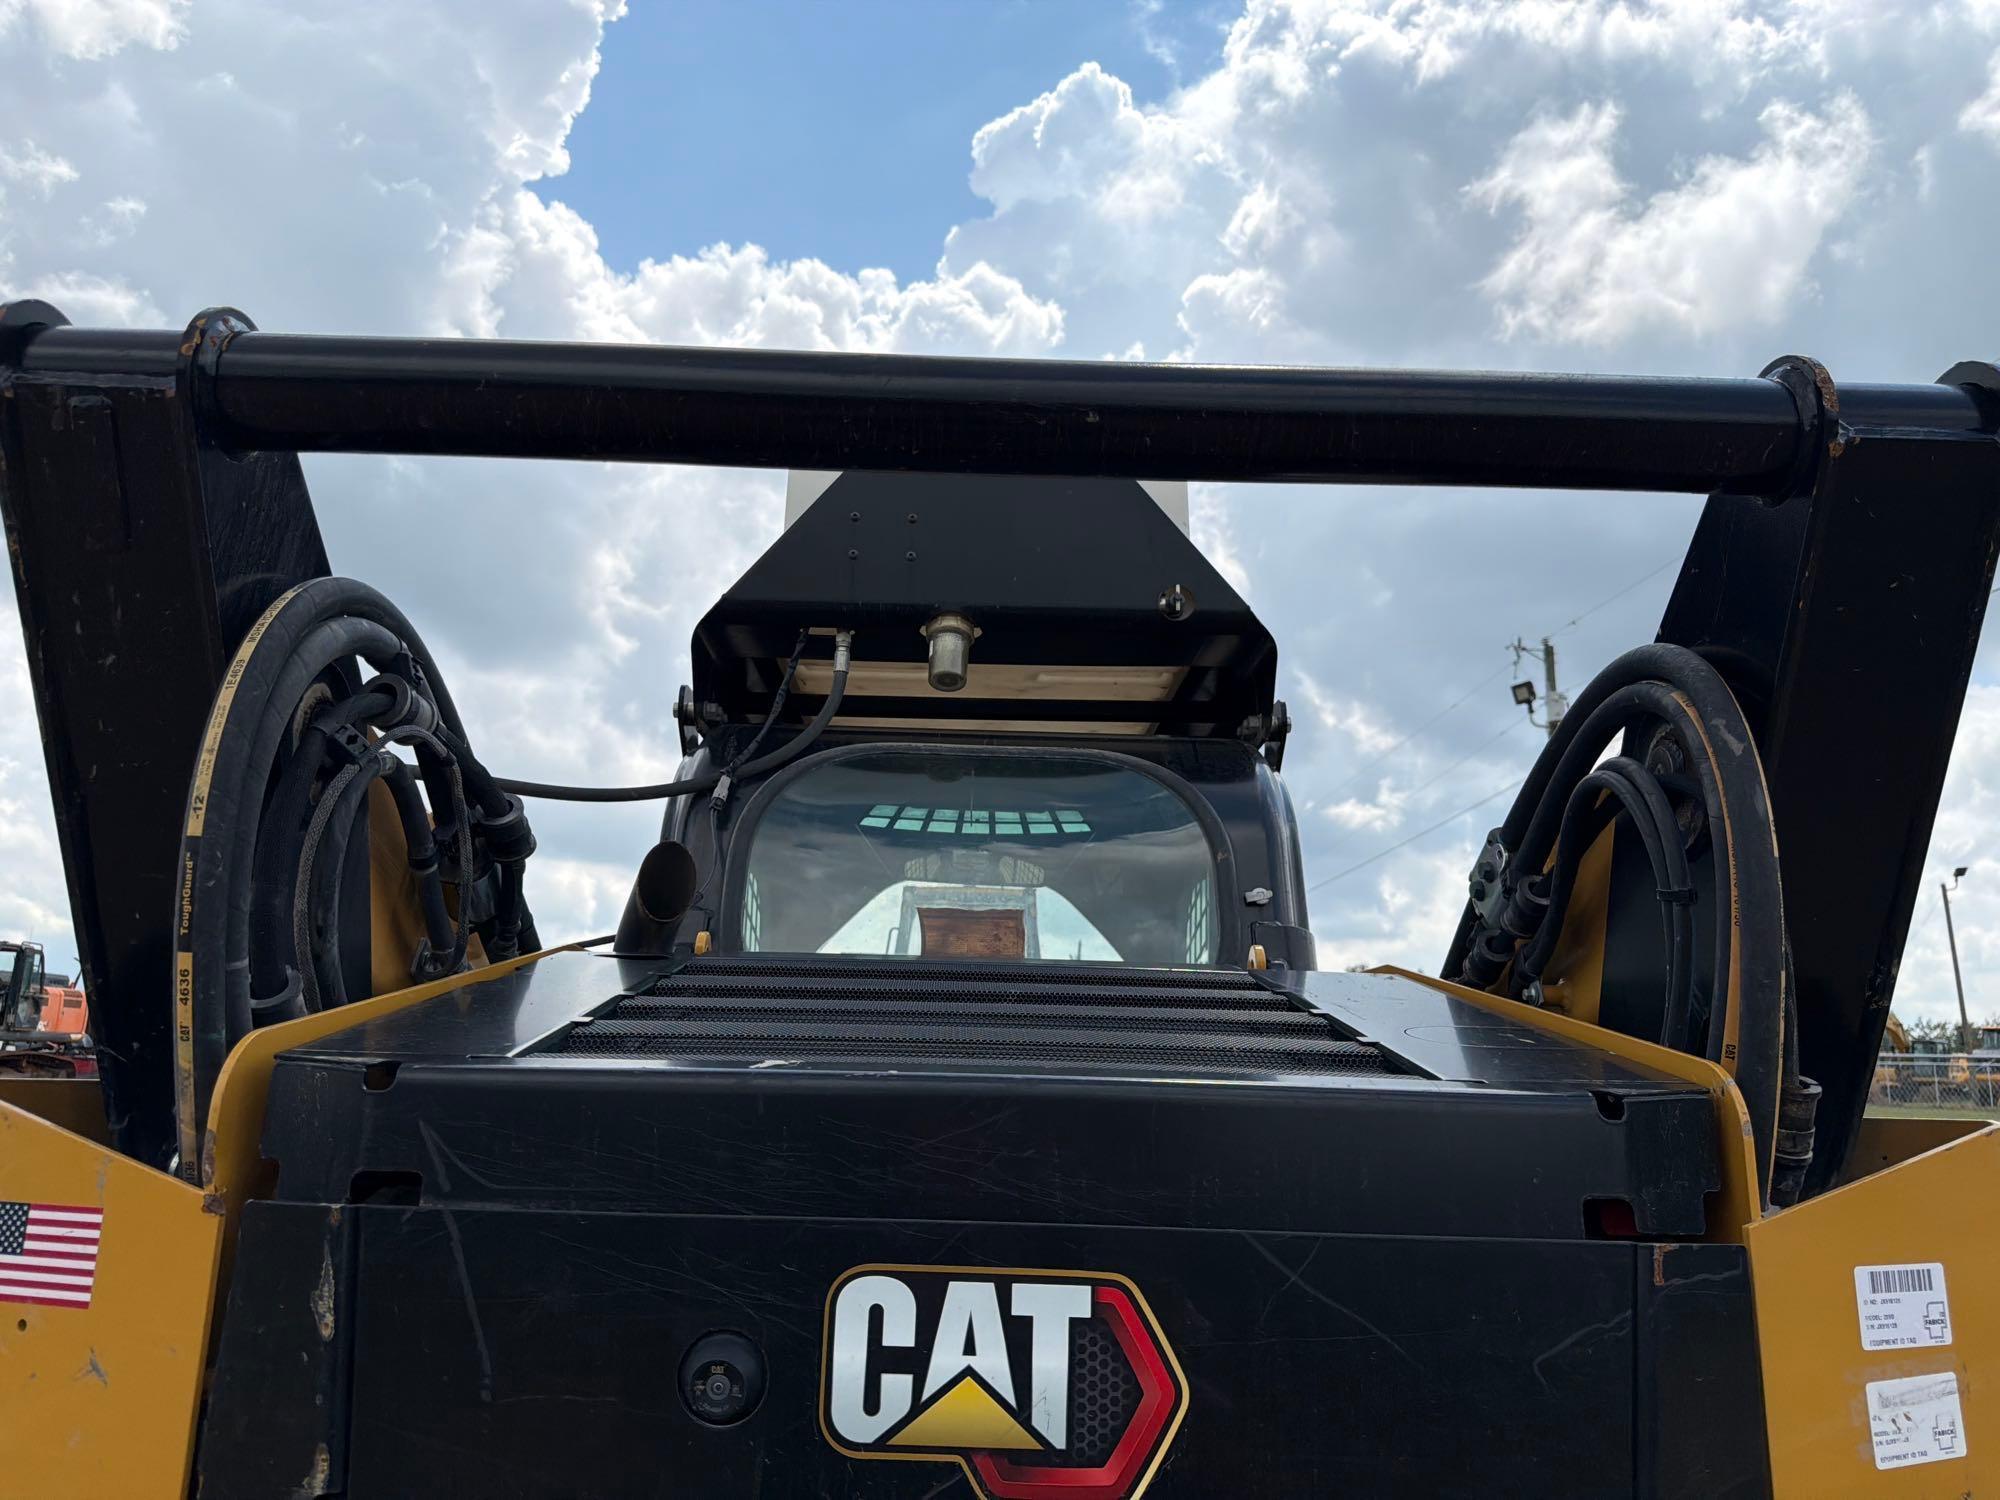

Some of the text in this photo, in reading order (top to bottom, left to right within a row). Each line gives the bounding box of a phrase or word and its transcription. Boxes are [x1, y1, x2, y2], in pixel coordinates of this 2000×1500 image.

[179, 968, 191, 1006] 4636
[179, 1024, 191, 1042] CAT
[1725, 1044, 1737, 1061] CAT
[831, 1276, 1092, 1449] CAT
[1880, 1452, 1909, 1463] EQUIPMENT
